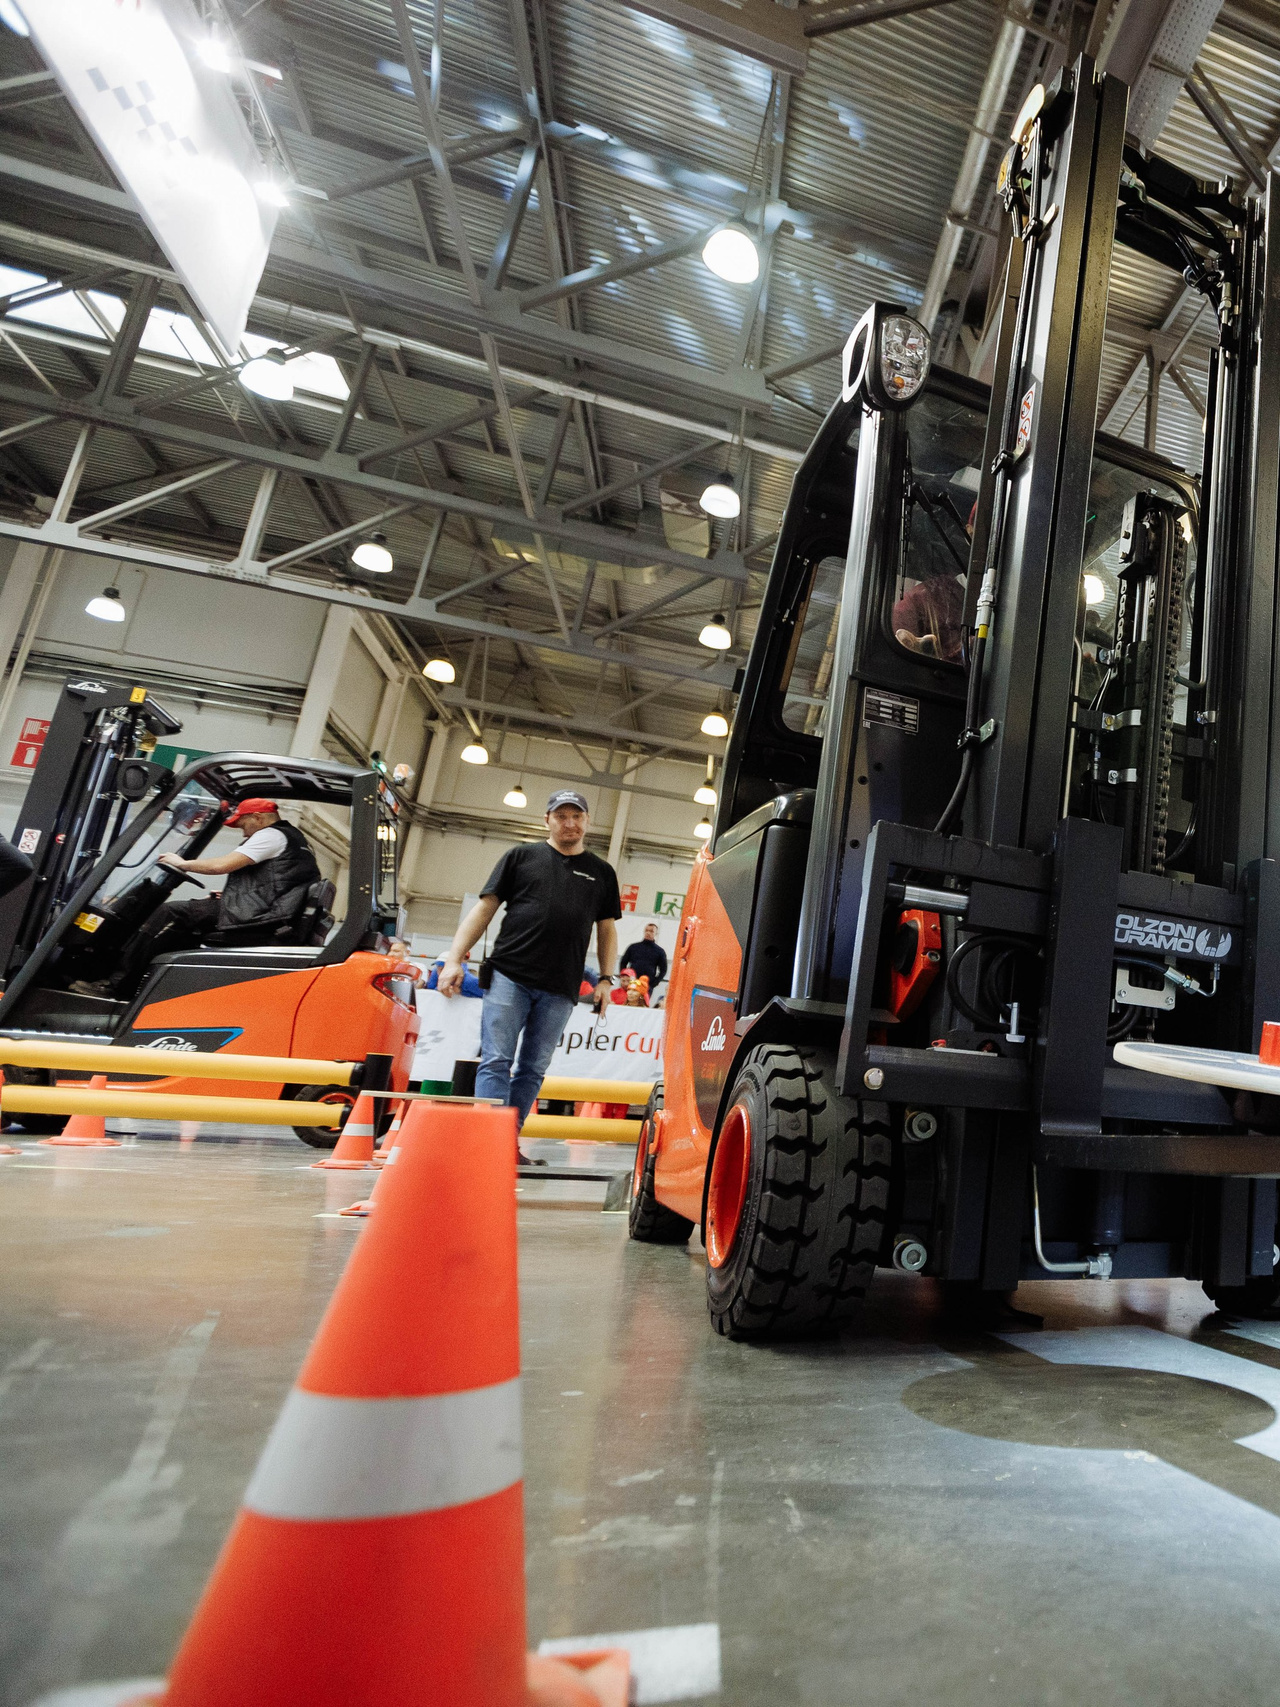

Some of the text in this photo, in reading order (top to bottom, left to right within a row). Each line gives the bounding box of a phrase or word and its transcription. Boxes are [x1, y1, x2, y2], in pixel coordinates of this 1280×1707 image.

[1115, 914, 1197, 940] OLZONI
[1114, 928, 1194, 953] URAMO
[134, 1036, 198, 1052] Linde
[701, 1015, 726, 1051] Linde
